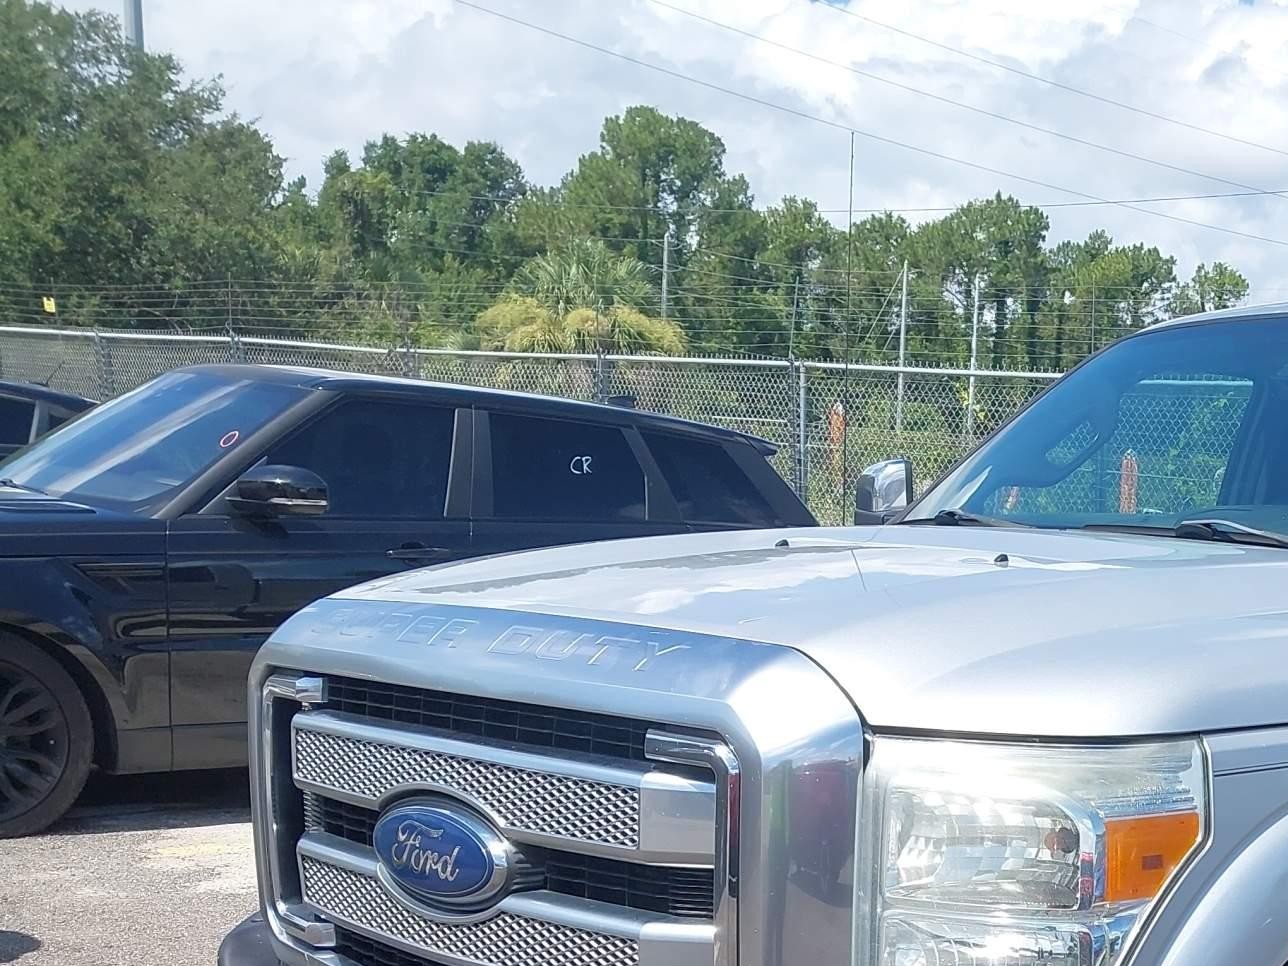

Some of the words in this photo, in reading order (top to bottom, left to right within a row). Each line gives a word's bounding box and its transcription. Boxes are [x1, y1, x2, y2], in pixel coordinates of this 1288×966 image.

[570, 455, 592, 474] CR
[312, 609, 480, 648] SUPER
[487, 625, 691, 672] DUTY
[391, 819, 461, 881] Ford
